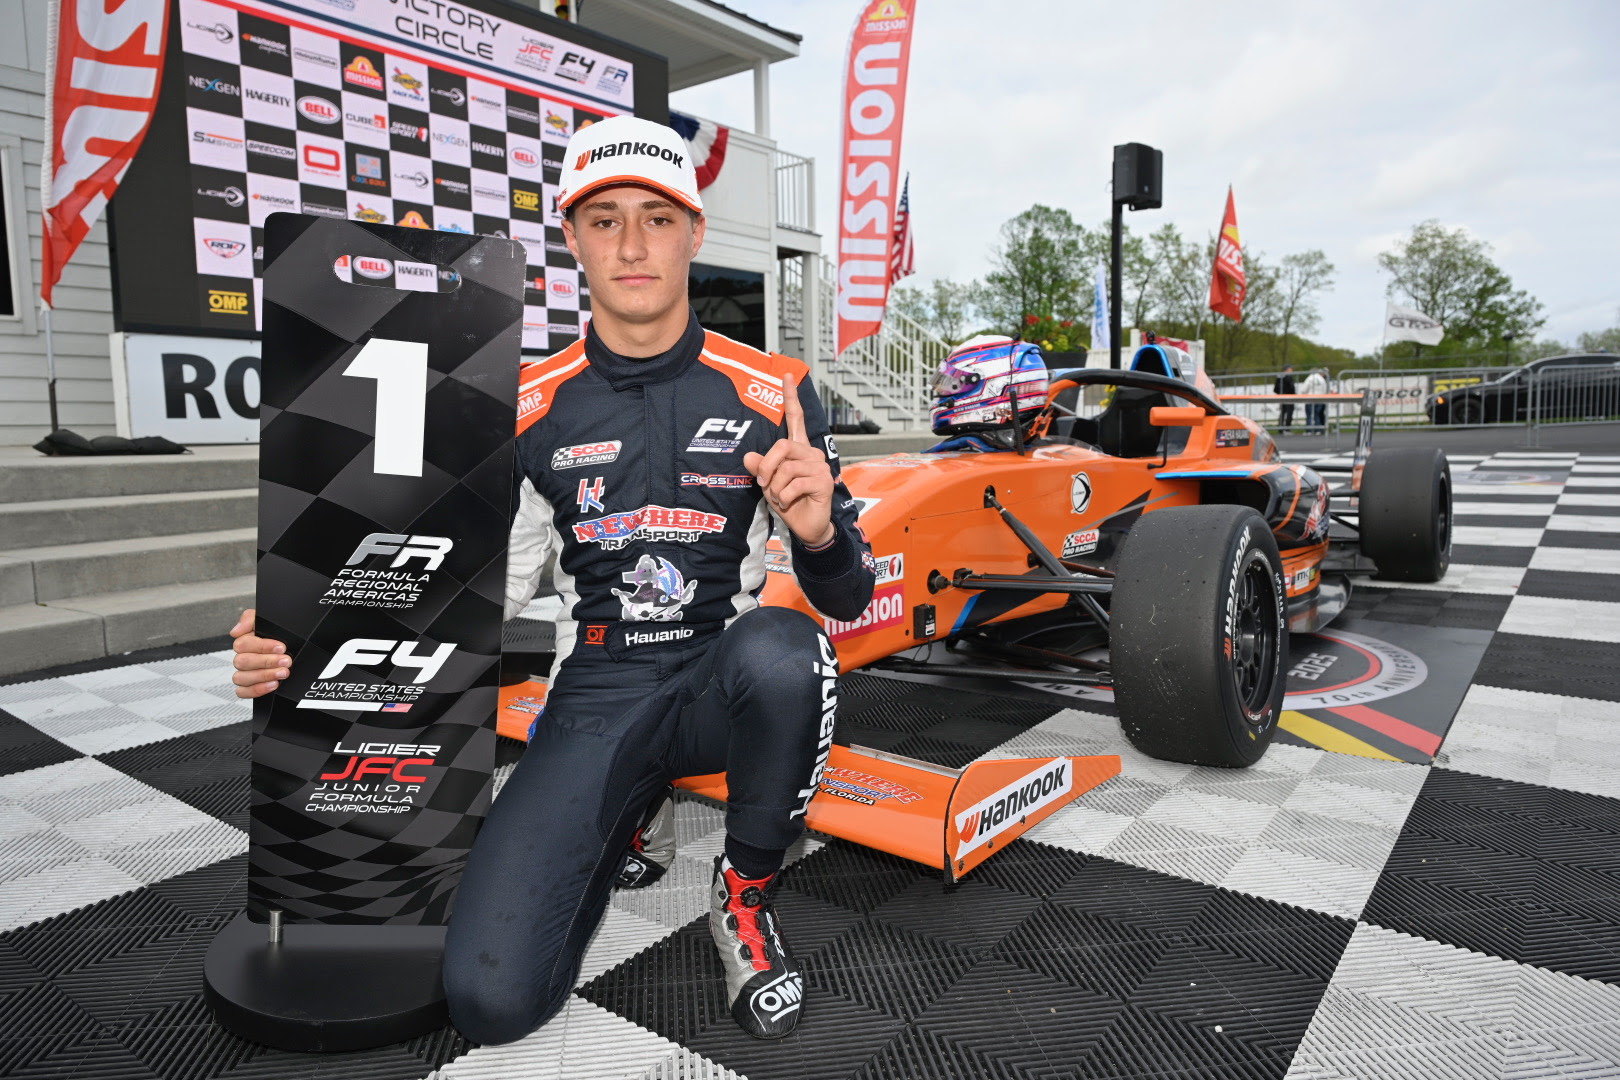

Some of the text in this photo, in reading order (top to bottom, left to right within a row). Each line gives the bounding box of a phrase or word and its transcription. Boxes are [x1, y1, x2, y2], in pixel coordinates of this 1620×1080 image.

[390, 0, 500, 36] ICTORY
[396, 16, 493, 60] CIRCLE
[518, 43, 553, 61] JFC
[560, 52, 596, 73] F4
[603, 65, 628, 82] FR
[189, 75, 240, 96] NEXGEN
[245, 88, 291, 107] HAGERTY
[304, 101, 335, 118] BELL
[392, 121, 418, 132] SPEED
[432, 132, 468, 148] NEXGEN
[248, 143, 294, 157] SPEEDCOM
[471, 141, 506, 158] HAGERTY
[514, 151, 536, 164] BELL
[513, 194, 539, 208] OMP
[361, 260, 387, 272] BELL
[398, 265, 434, 278] HAGERTY
[553, 283, 573, 294] BELL
[209, 294, 248, 310] OMP
[747, 383, 784, 407] OMP
[341, 337, 429, 477] 1
[517, 392, 543, 415] MP
[694, 418, 753, 440] F4
[572, 443, 617, 457] SCCA
[554, 453, 616, 468] PRO RACING
[681, 475, 753, 486] CROSSLINK
[601, 528, 702, 550] TRANSPORT
[1074, 532, 1097, 545] SCCA
[345, 532, 454, 571] FR
[1062, 543, 1096, 556] PRO RACING
[337, 568, 430, 583] FORMULA
[330, 578, 423, 592] REGIONAL
[324, 588, 419, 602] AMERICAS
[318, 598, 414, 609] CHAMPIONSHIP
[625, 627, 694, 646] Hauanio
[317, 638, 458, 684] F4
[1287, 652, 1339, 681] 2025
[304, 690, 419, 702] CHAMPIONSHIP
[310, 681, 426, 695] UNITED STATES
[333, 741, 442, 757] LIGIER
[320, 756, 435, 783] JFC
[314, 782, 421, 794] JUNIOR
[831, 767, 925, 804] WHERE
[309, 792, 414, 804] FORMULA
[824, 787, 875, 805] FLORIDA
[305, 803, 411, 814] CHAMPIONSHIP
